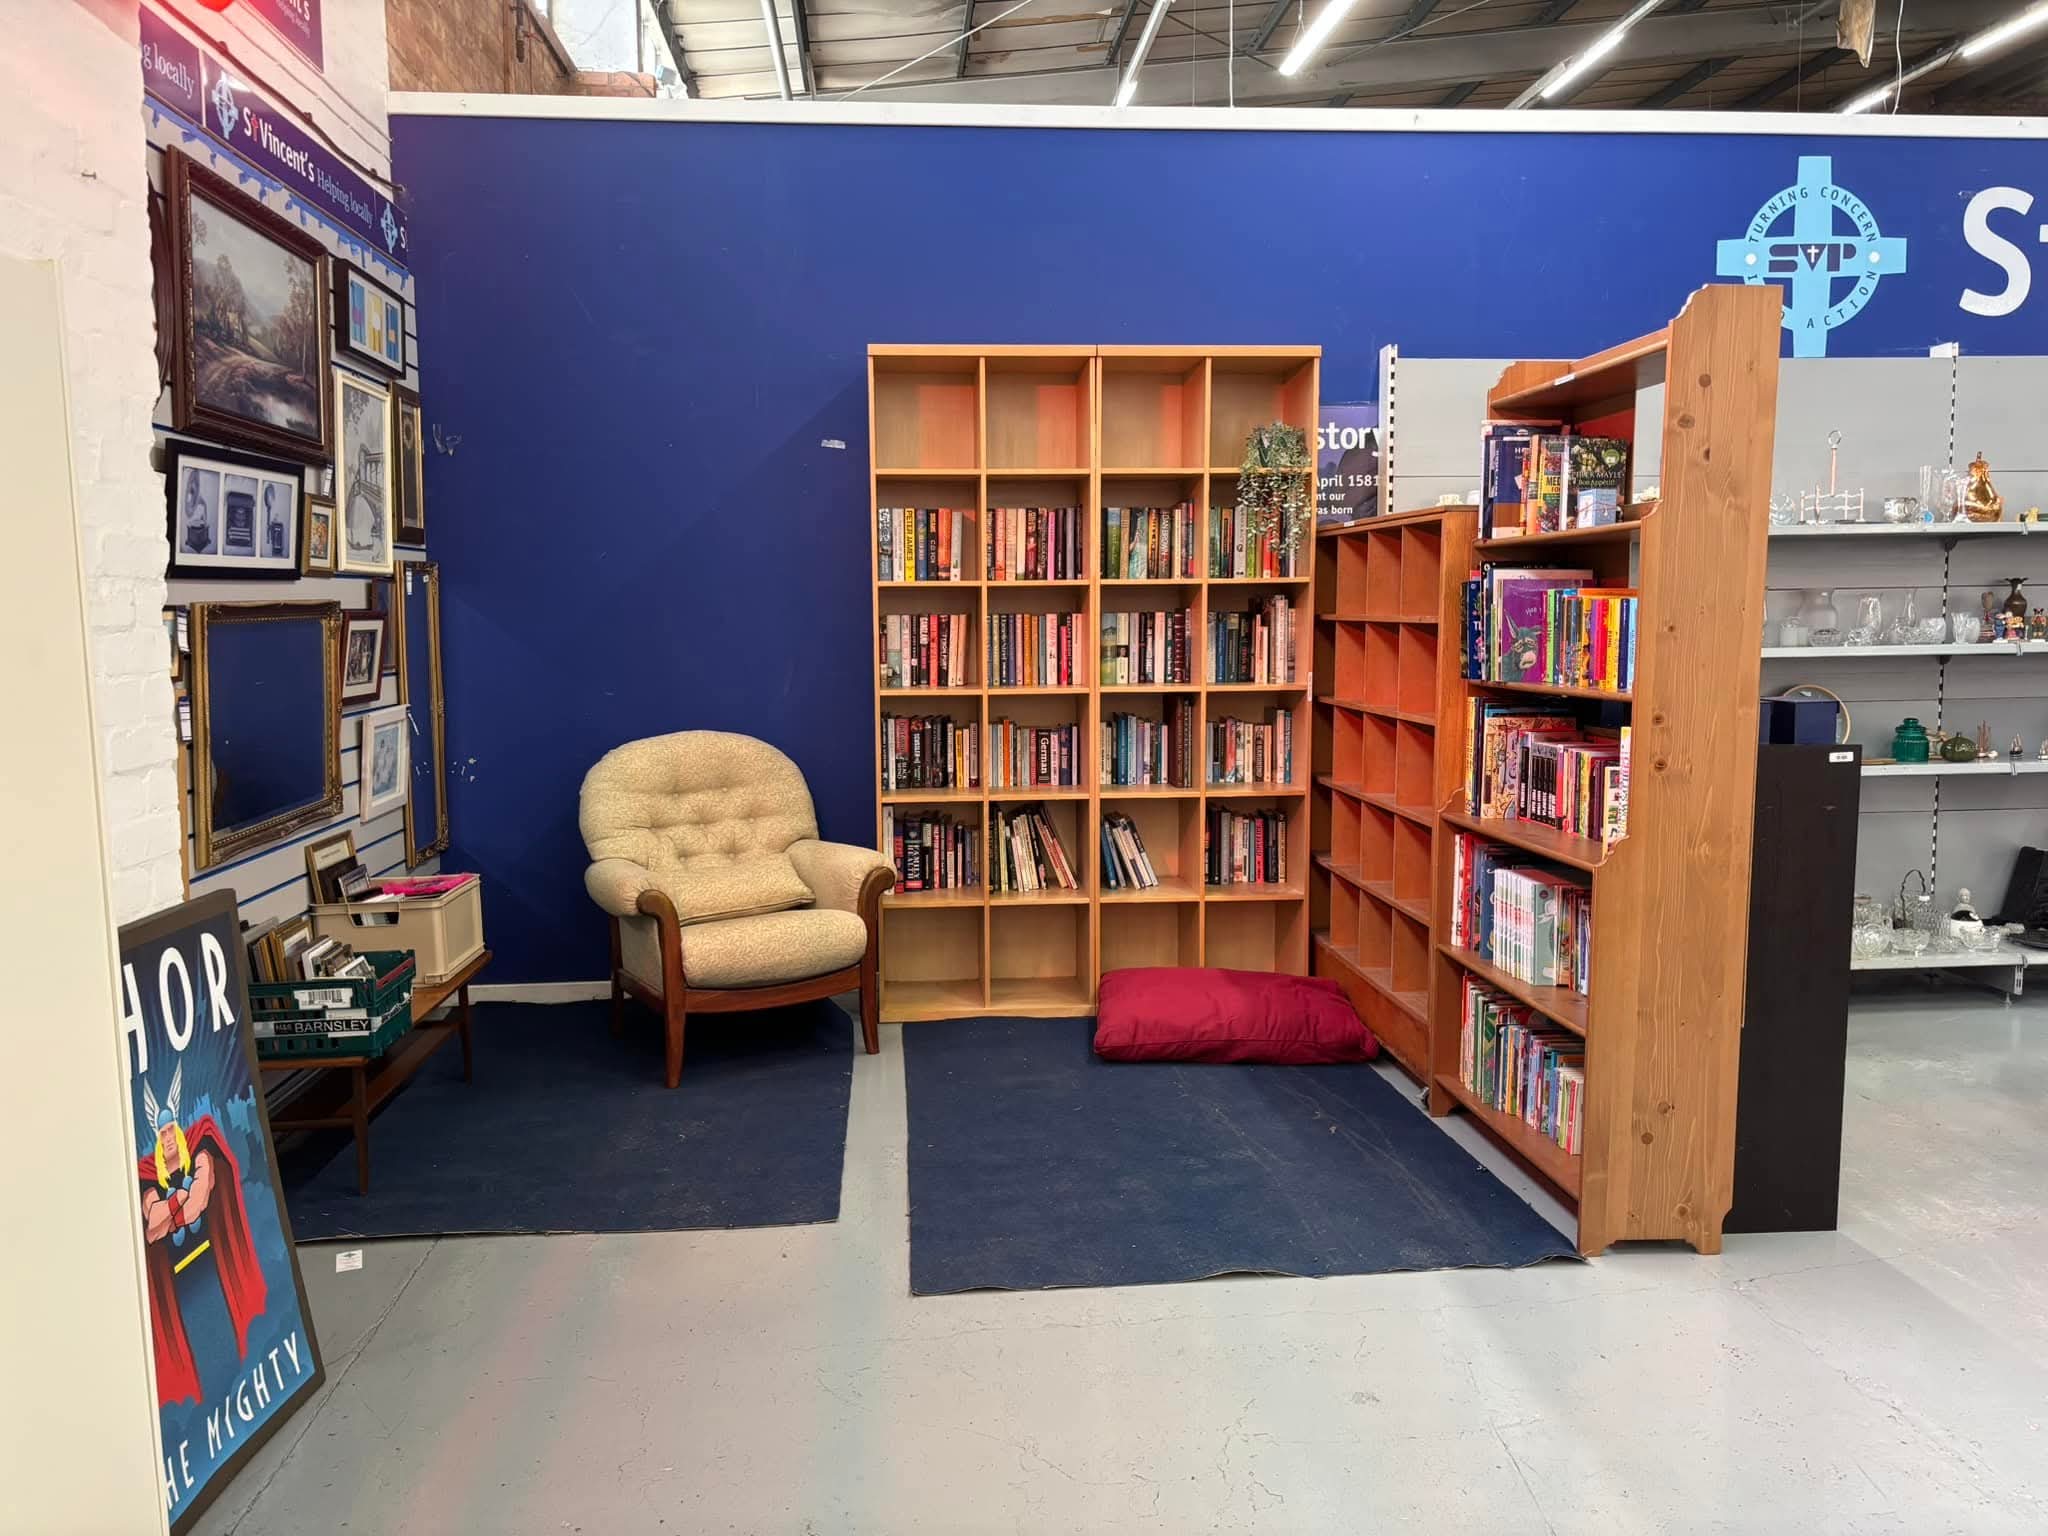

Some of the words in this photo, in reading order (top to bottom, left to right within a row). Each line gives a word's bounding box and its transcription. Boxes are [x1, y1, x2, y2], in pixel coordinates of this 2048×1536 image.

[153, 42, 195, 99] locally
[317, 168, 350, 212] Helping
[350, 192, 374, 229] locally
[1749, 186, 1808, 244] TURNING
[1820, 186, 1877, 243] CONCERN
[1806, 271, 1878, 329] ACTION
[1329, 493, 1346, 501] our
[1331, 506, 1353, 514] born
[906, 510, 914, 535] PETER
[1161, 530, 1169, 555] BROWN
[906, 536, 914, 561] JAMES
[1040, 737, 1049, 774] German
[122, 931, 236, 1075] HOR
[294, 1019, 370, 1034] BARNSLEY
[165, 1440, 195, 1511] HE
[206, 1331, 301, 1460] MIGHTY
